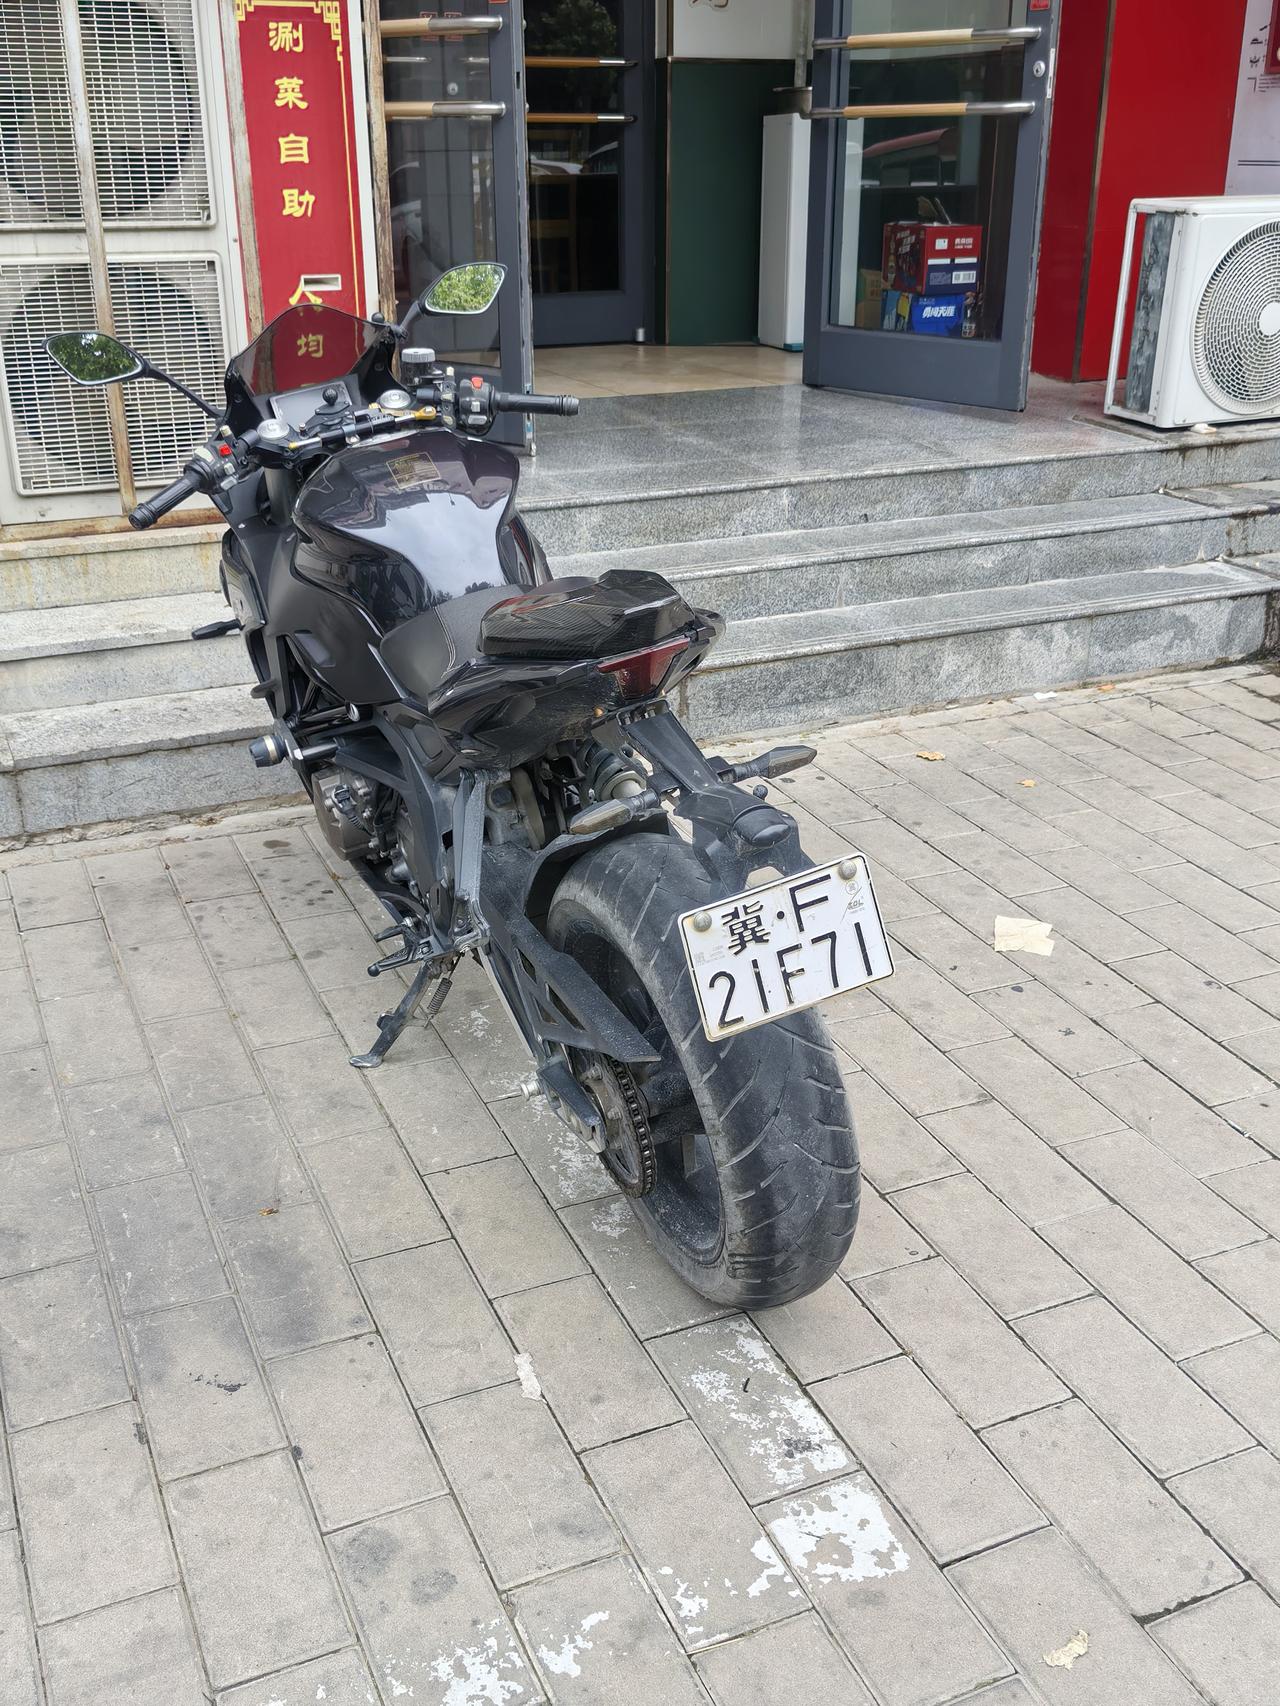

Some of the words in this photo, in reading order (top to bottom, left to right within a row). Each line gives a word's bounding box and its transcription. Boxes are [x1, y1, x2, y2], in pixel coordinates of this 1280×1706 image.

[268, 21, 316, 219] 涮菜自助
[708, 921, 873, 1029] 21F71
